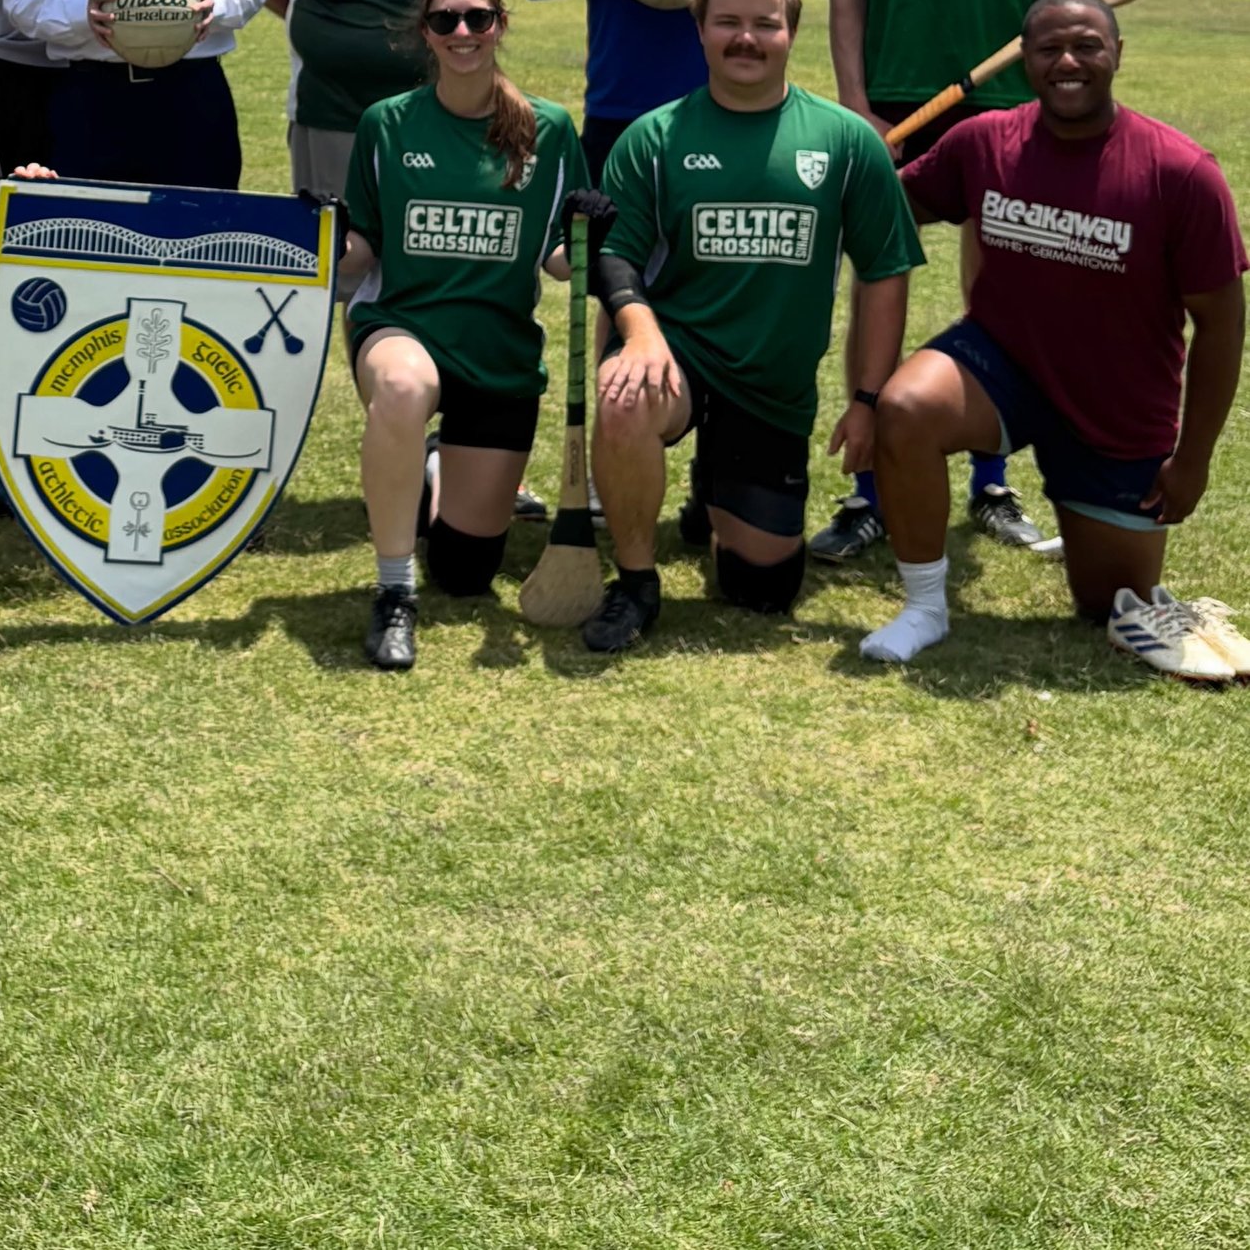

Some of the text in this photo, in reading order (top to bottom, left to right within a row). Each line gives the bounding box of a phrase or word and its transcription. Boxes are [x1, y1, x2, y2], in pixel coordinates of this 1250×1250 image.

[402, 152, 435, 168] GAA
[683, 153, 723, 170] GAA
[410, 206, 504, 236] CELTIC
[698, 209, 797, 238] CELTIC
[982, 189, 1132, 254] Breakaway
[408, 232, 500, 254] CROSSING
[698, 237, 794, 257] CROSSING
[50, 329, 122, 393] memphis
[192, 340, 244, 395] gaelic
[38, 460, 104, 534] athletic
[163, 468, 246, 541] association
